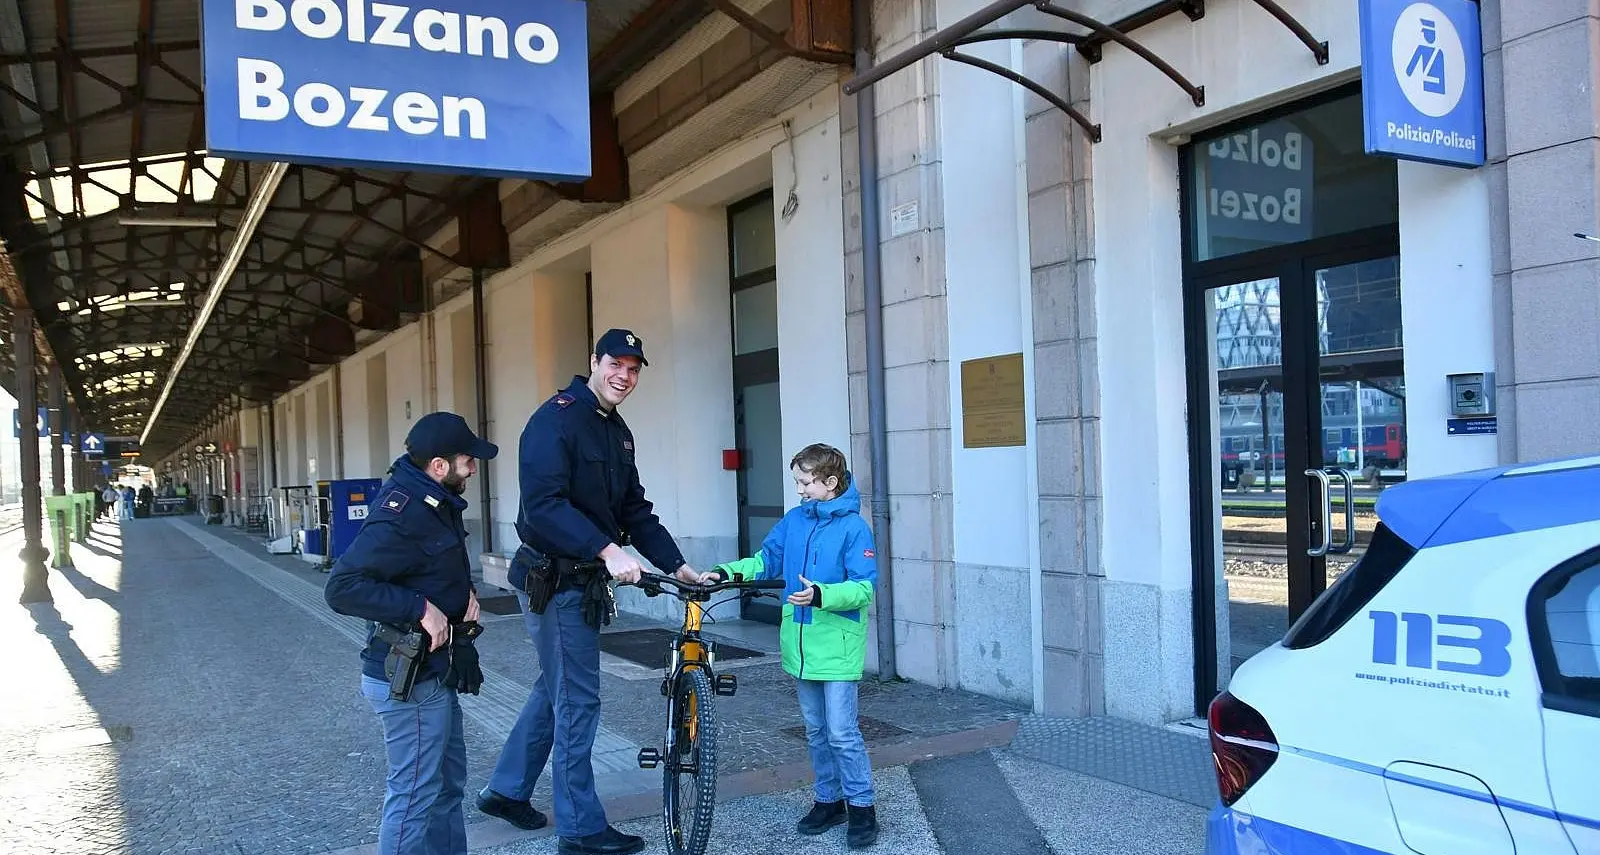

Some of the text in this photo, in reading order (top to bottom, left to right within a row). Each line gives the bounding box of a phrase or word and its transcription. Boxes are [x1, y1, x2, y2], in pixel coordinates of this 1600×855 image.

[237, 57, 486, 140] Bozen
[1387, 121, 1476, 150] Polizia/Polizei
[353, 509, 364, 517] 13
[1369, 610, 1512, 677] 113
[1355, 673, 1511, 698] www.poliziadistato.it
